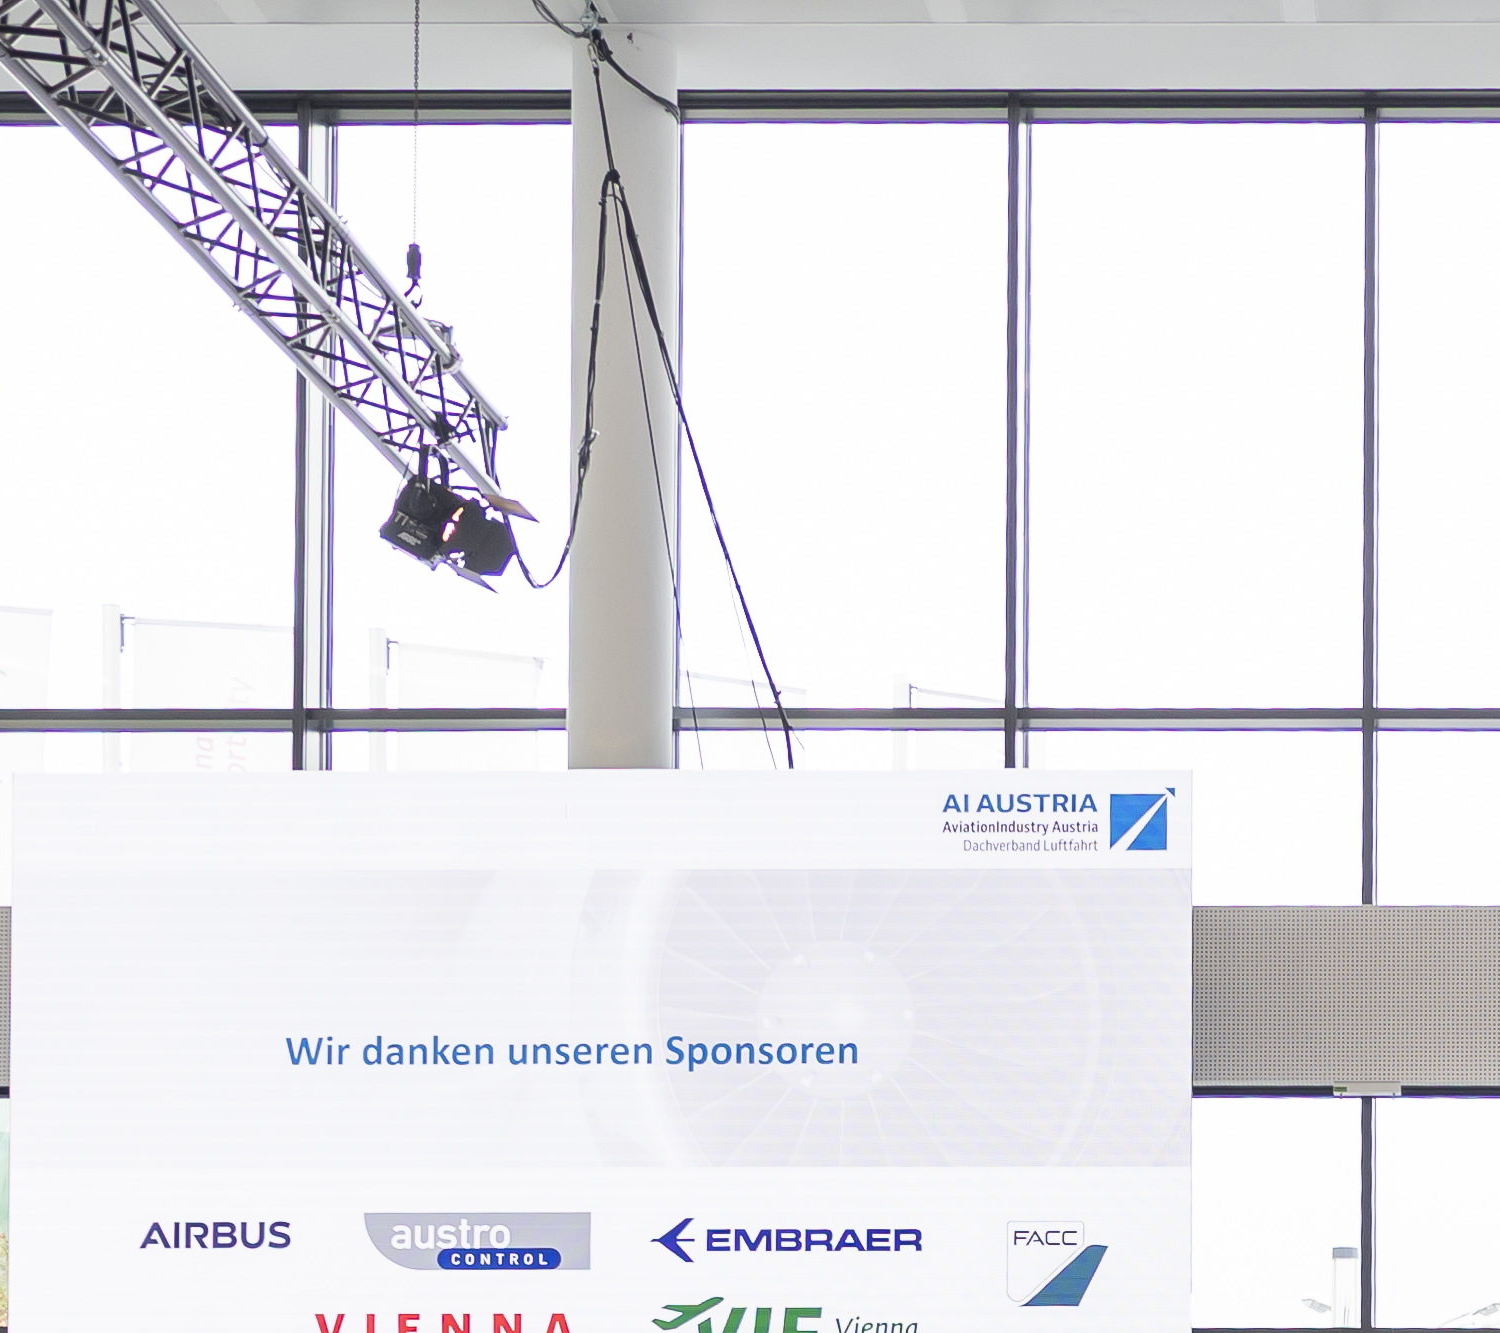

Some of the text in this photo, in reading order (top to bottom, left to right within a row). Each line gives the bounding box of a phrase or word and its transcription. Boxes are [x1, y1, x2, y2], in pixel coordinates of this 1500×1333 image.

[943, 794, 1097, 812] AI AUSTRIA
[943, 821, 1098, 836] AviationIndustry Austria
[964, 840, 1097, 851] Dachverband Luftfahrt
[286, 1036, 857, 1072] Wir danken unseren Sponsoren
[140, 1222, 290, 1249] AIRBUS
[391, 1219, 511, 1250] austro
[707, 1229, 922, 1251] EMBRAER
[1014, 1231, 1077, 1245] FACC
[451, 1253, 548, 1265] CONTROL
